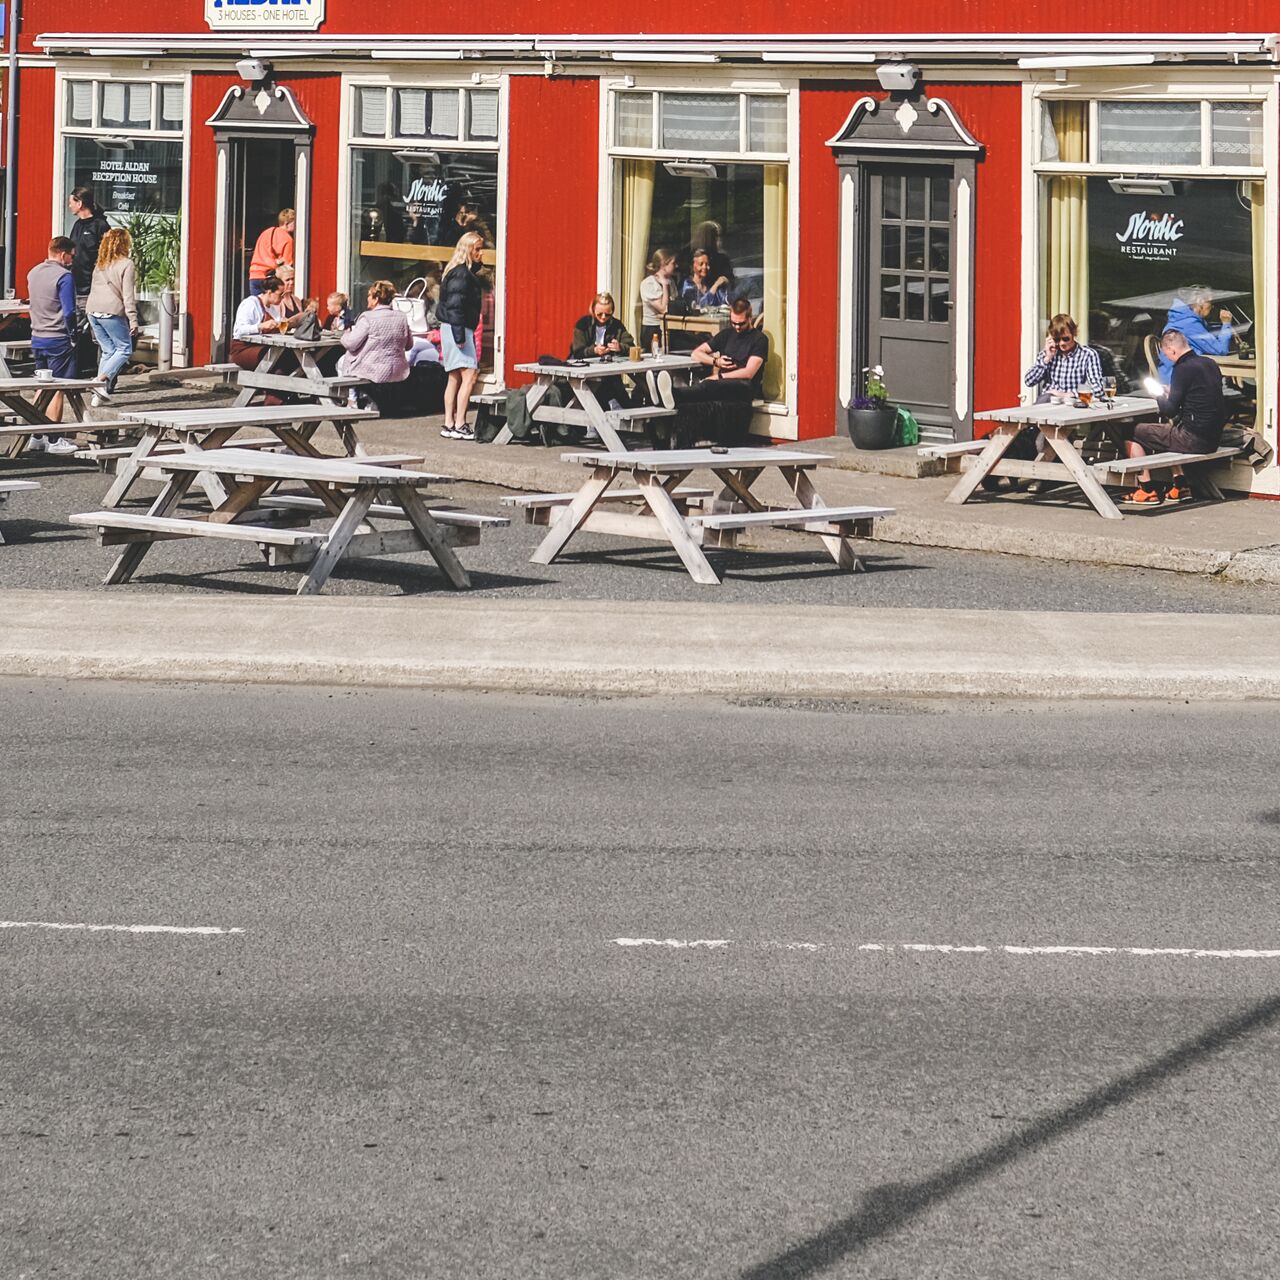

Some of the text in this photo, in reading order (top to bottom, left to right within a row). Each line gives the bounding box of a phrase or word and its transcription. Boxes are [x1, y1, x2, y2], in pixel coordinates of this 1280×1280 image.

[218, 10, 223, 21] 3
[224, 10, 257, 21] HOUSES
[263, 10, 281, 21] ONE
[283, 10, 310, 21] HOTEL
[100, 161, 150, 172] HOTEL ALDAN
[92, 172, 158, 184] RECEPTION HOUSE
[402, 177, 449, 204] Nordic
[1115, 210, 1185, 243] Nordic
[1120, 245, 1178, 256] RESTAURANT
